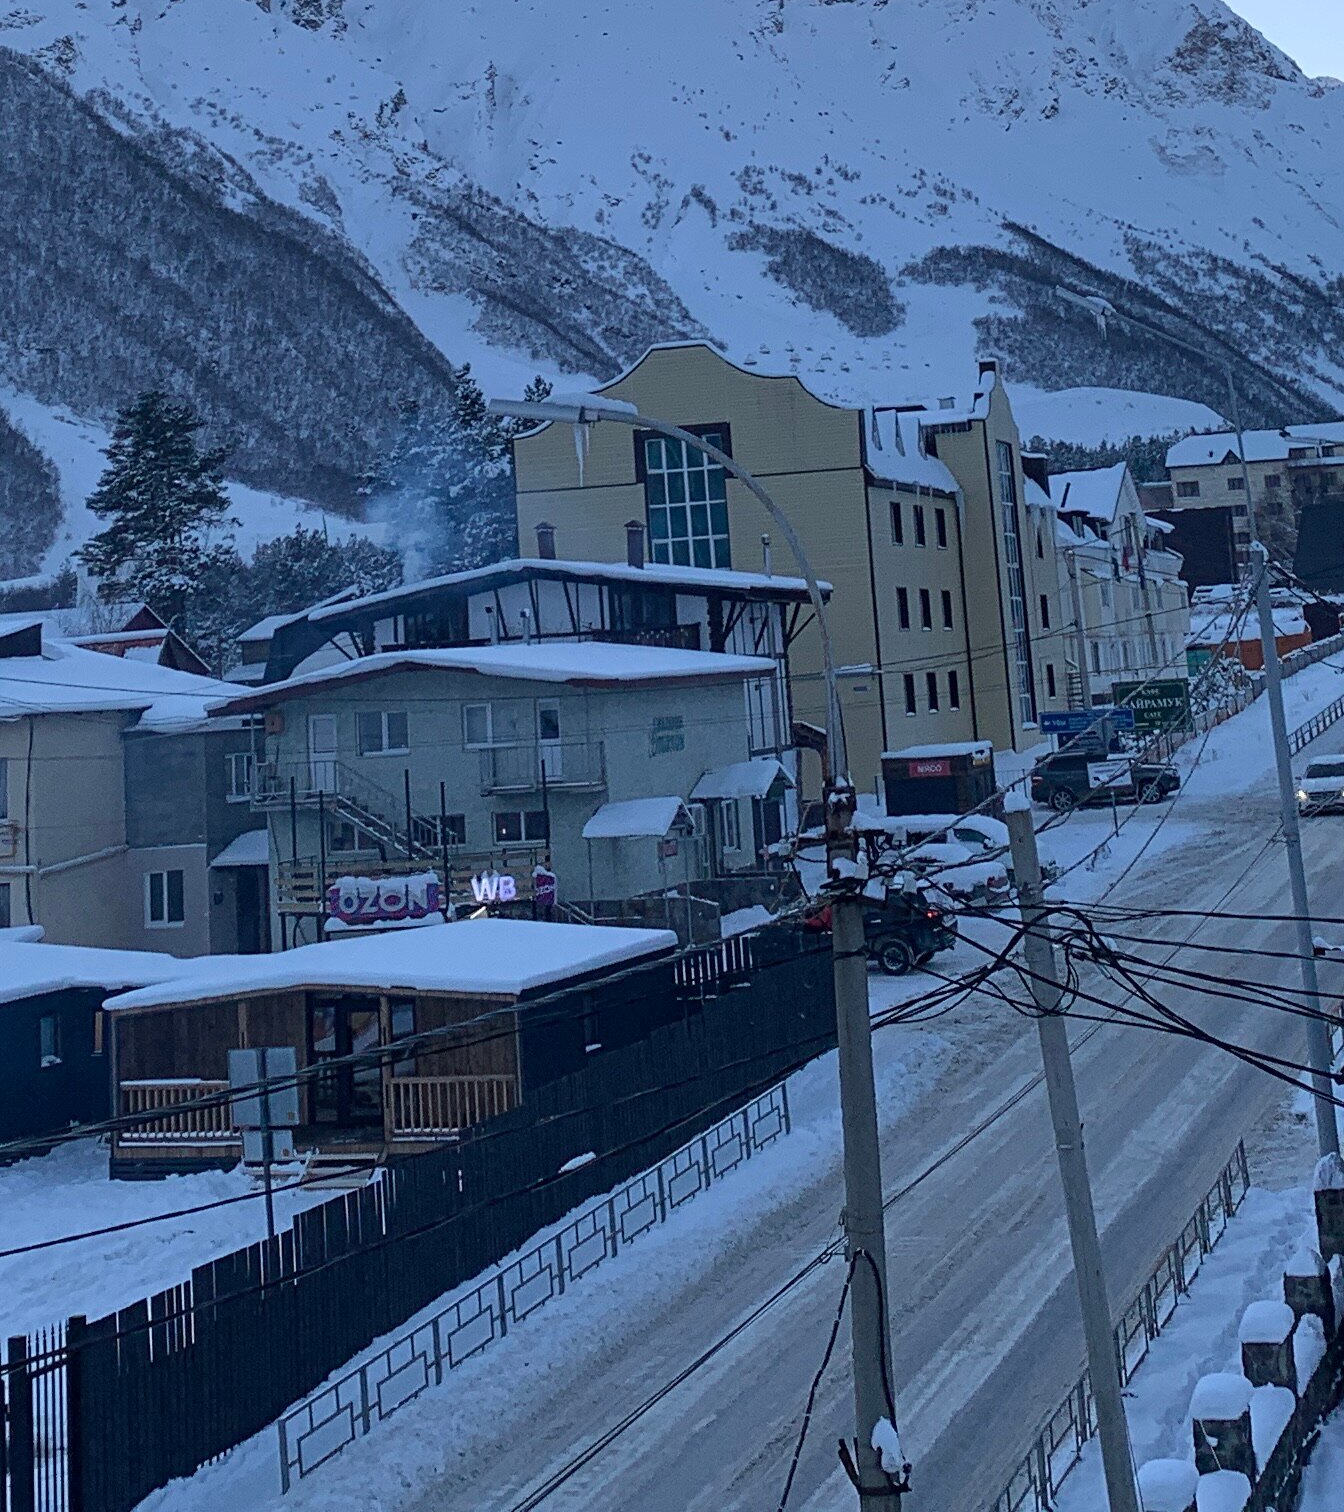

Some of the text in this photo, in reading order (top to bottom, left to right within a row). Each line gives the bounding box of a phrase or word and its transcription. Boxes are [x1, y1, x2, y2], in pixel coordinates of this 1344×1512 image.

[1121, 696, 1183, 710] АЙРАМУК
[340, 883, 429, 914] OZON
[471, 875, 516, 901] WB
